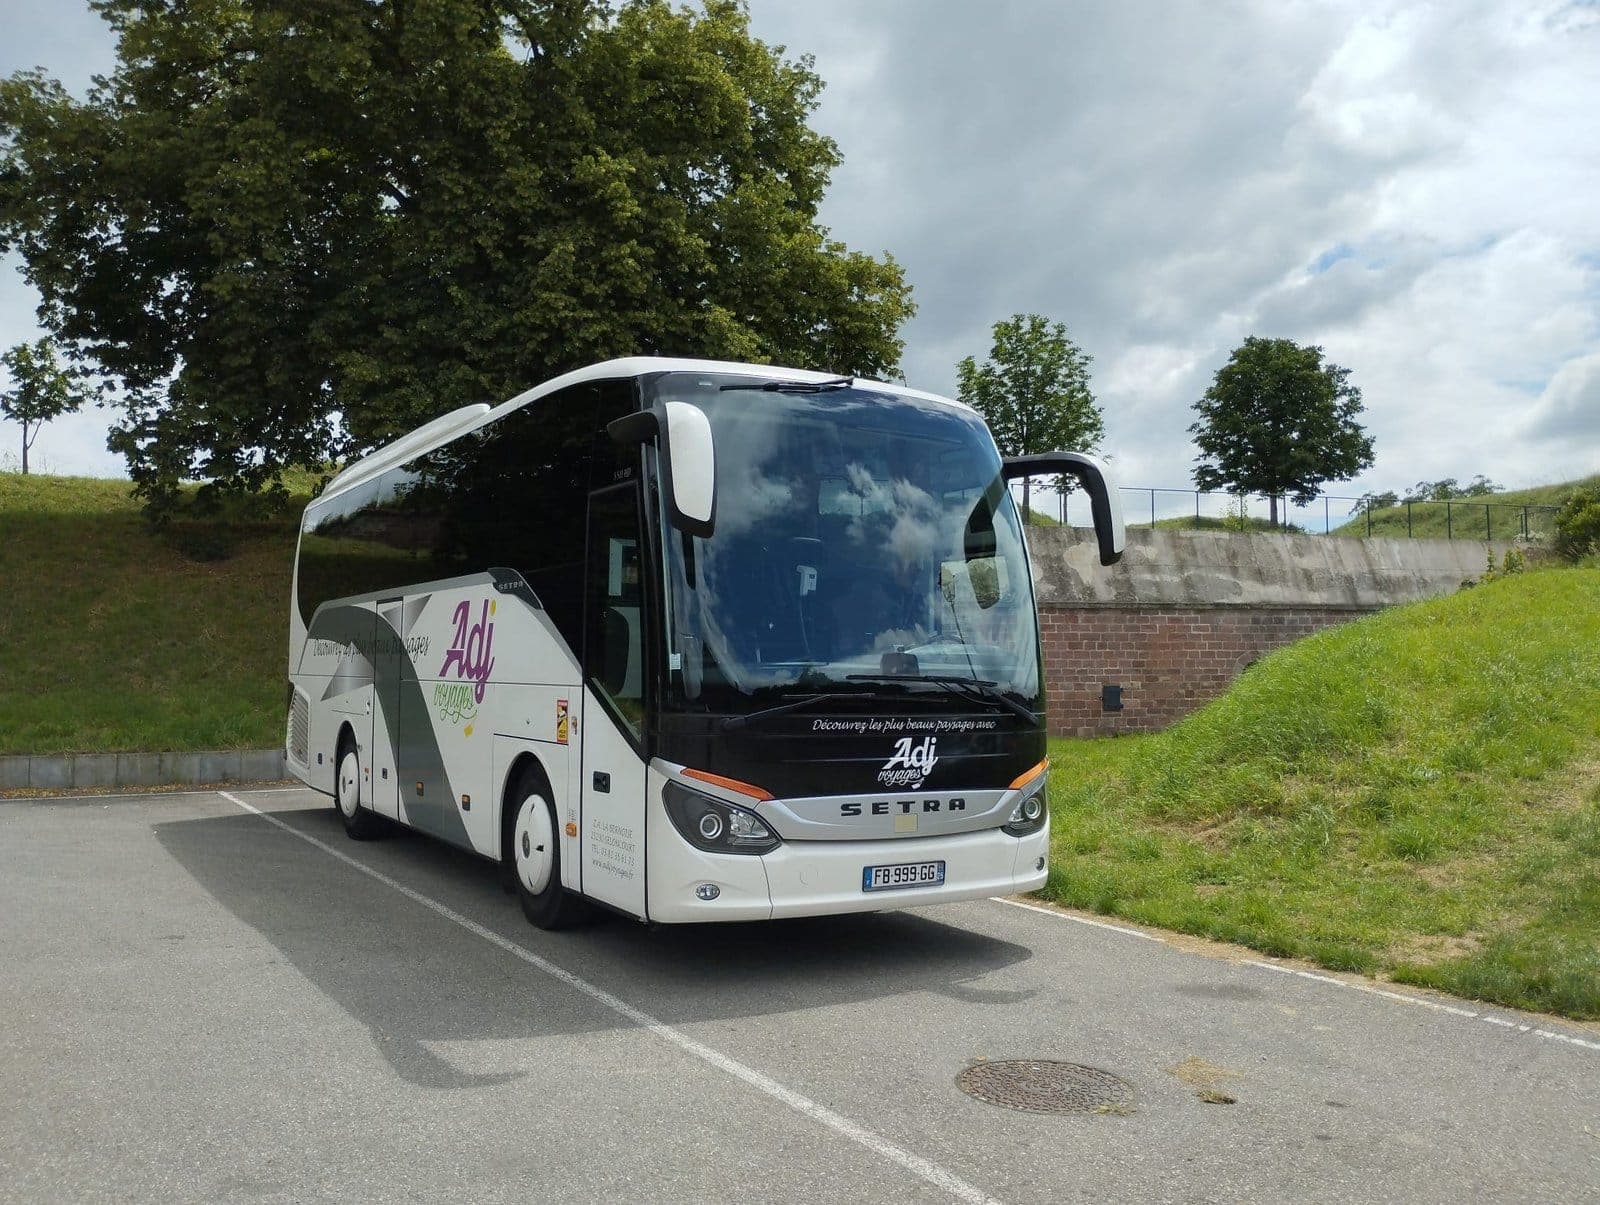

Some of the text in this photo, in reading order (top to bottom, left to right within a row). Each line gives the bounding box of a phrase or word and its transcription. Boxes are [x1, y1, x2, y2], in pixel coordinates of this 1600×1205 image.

[498, 580, 524, 591] SETRA
[438, 599, 496, 704] Adj
[433, 682, 476, 724] voyages
[812, 718, 996, 734] Découvrez les plus beaux paysages avec
[882, 736, 939, 775] Adj
[877, 768, 924, 786] voyages
[840, 798, 966, 816] SETRA
[874, 865, 935, 885] FB-999-GG
